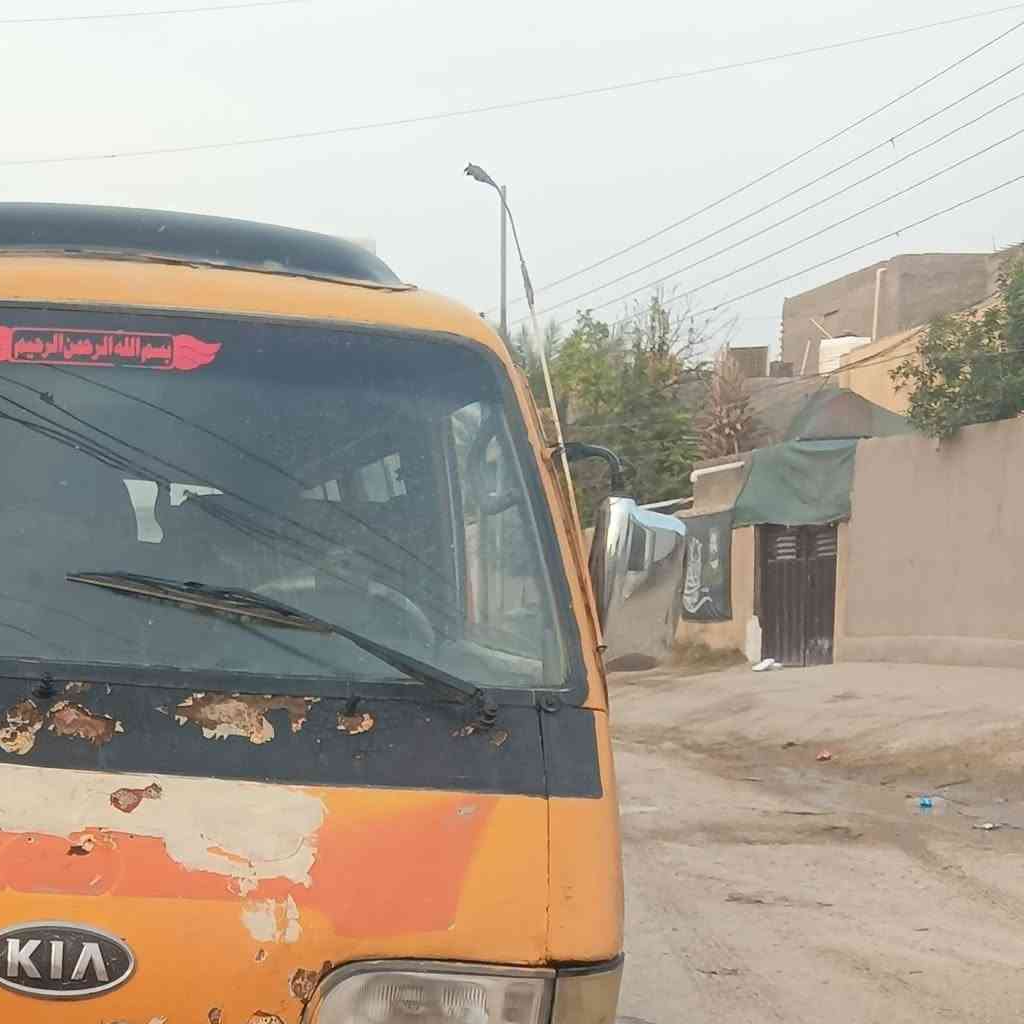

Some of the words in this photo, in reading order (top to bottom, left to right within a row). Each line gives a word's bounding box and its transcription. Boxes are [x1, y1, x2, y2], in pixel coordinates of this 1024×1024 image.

[14, 332, 64, 360] الرحيم
[64, 333, 113, 361] الرحمن
[114, 335, 141, 359] الله
[141, 341, 171, 364] بسم
[6, 938, 109, 982] KIA
